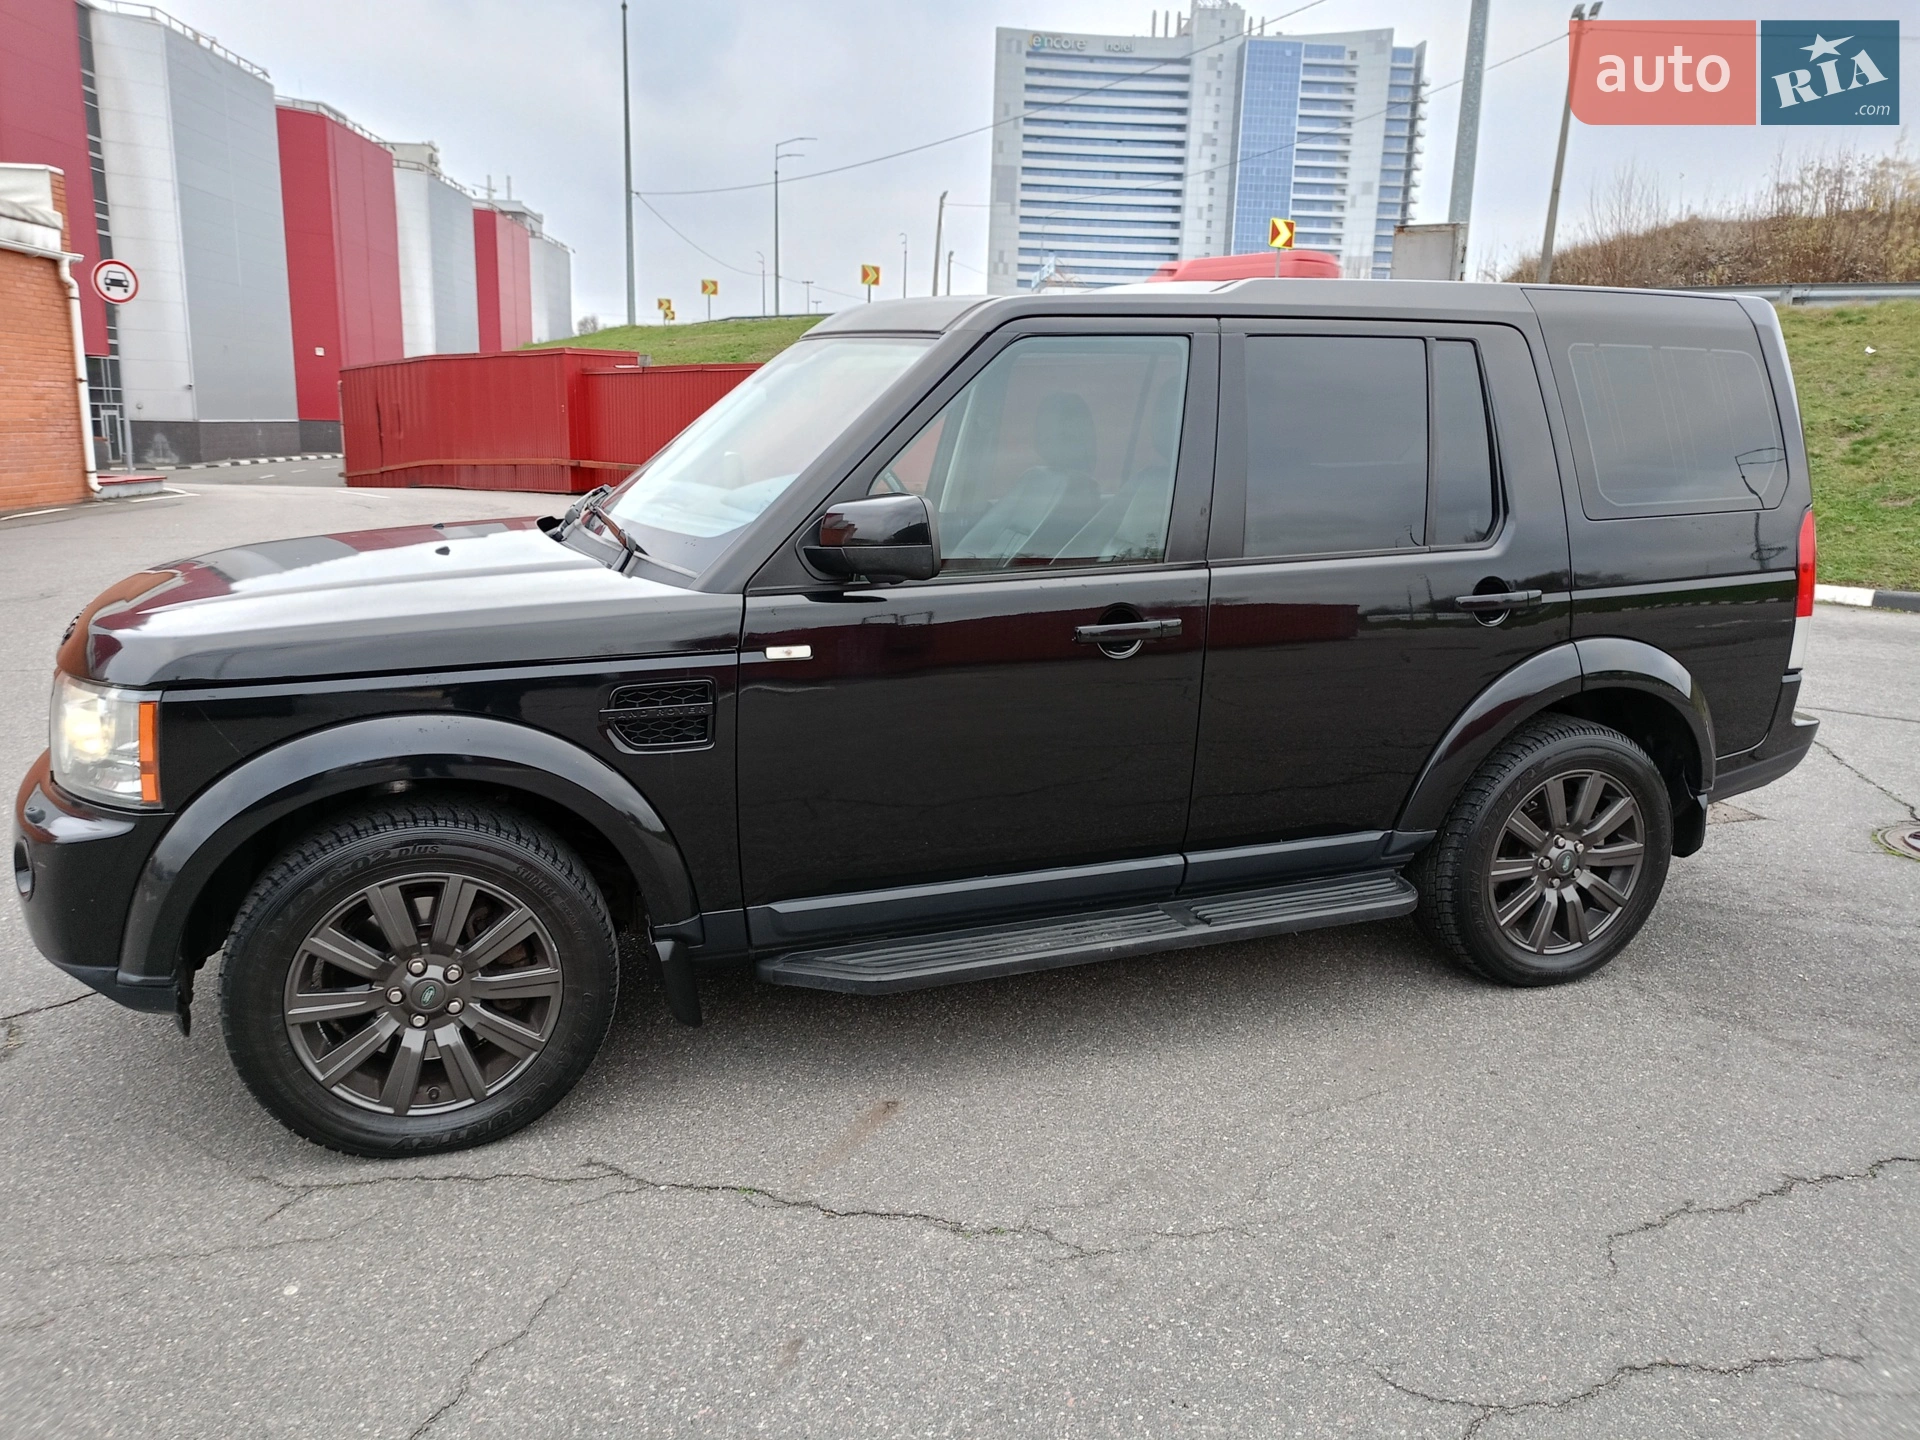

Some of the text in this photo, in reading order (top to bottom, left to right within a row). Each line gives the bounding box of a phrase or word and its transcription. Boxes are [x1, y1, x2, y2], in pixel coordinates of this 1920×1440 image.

[1030, 34, 1088, 51] encore
[607, 706, 708, 720] LAND ROVER
[400, 842, 440, 857] plus
